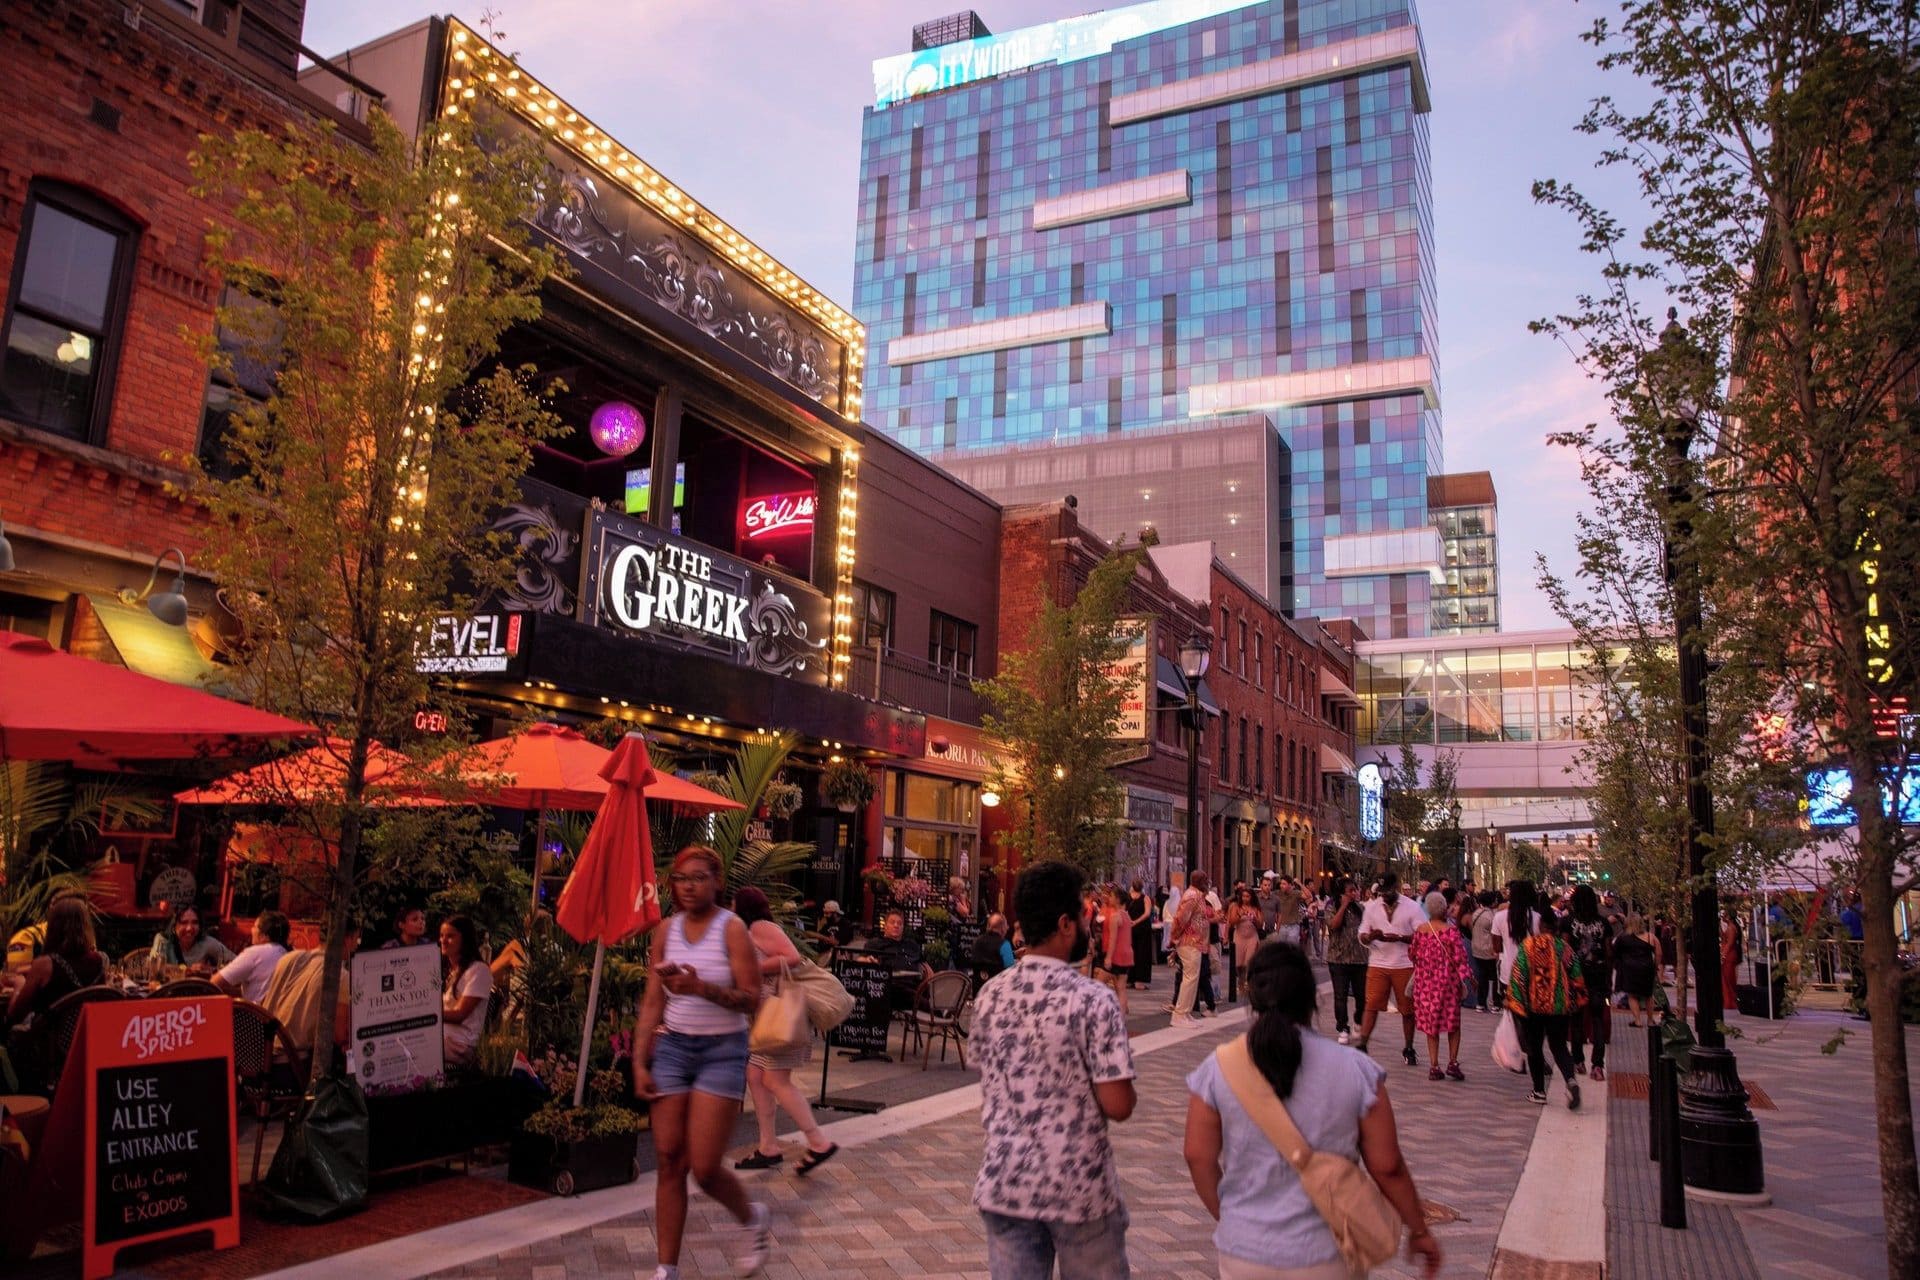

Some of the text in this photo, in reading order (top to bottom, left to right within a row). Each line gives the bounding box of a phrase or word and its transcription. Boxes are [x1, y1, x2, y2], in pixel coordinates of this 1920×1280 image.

[665, 543, 712, 581] THE
[611, 544, 749, 643] GREEK
[1855, 507, 1893, 683] ASINO
[415, 710, 447, 733] OPEN
[1120, 721, 1140, 731] OPA!
[634, 881, 659, 912] P
[369, 989, 430, 1008] THANK YOU
[122, 1004, 206, 1048] APEROL
[117, 1078, 159, 1100] USE
[112, 1104, 172, 1131] ALLEY
[107, 1129, 199, 1164] ENTRANCE
[122, 1195, 188, 1224] EXODOS
